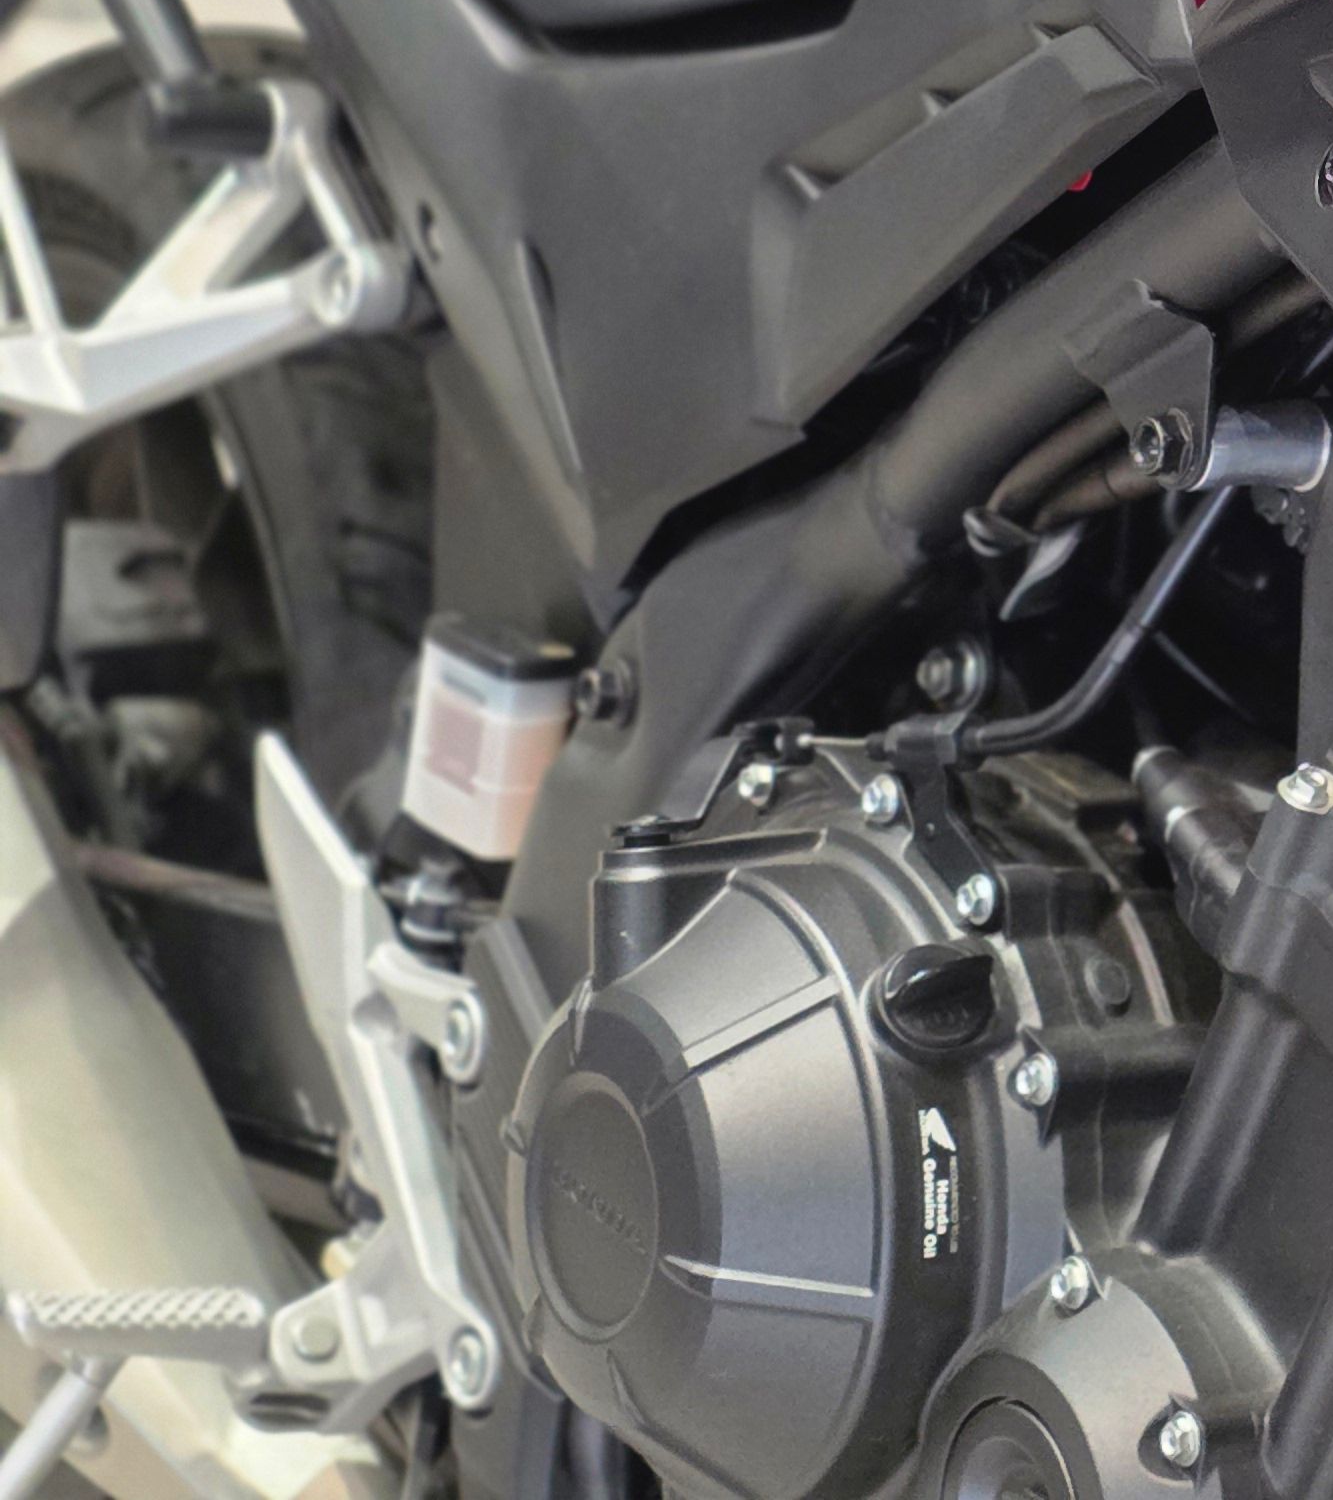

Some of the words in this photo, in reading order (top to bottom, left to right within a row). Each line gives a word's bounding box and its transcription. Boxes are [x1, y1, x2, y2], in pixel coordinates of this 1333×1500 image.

[923, 1158, 937, 1230] Genuine
[936, 1179, 948, 1235] Honda
[923, 1233, 937, 1259] Oil
